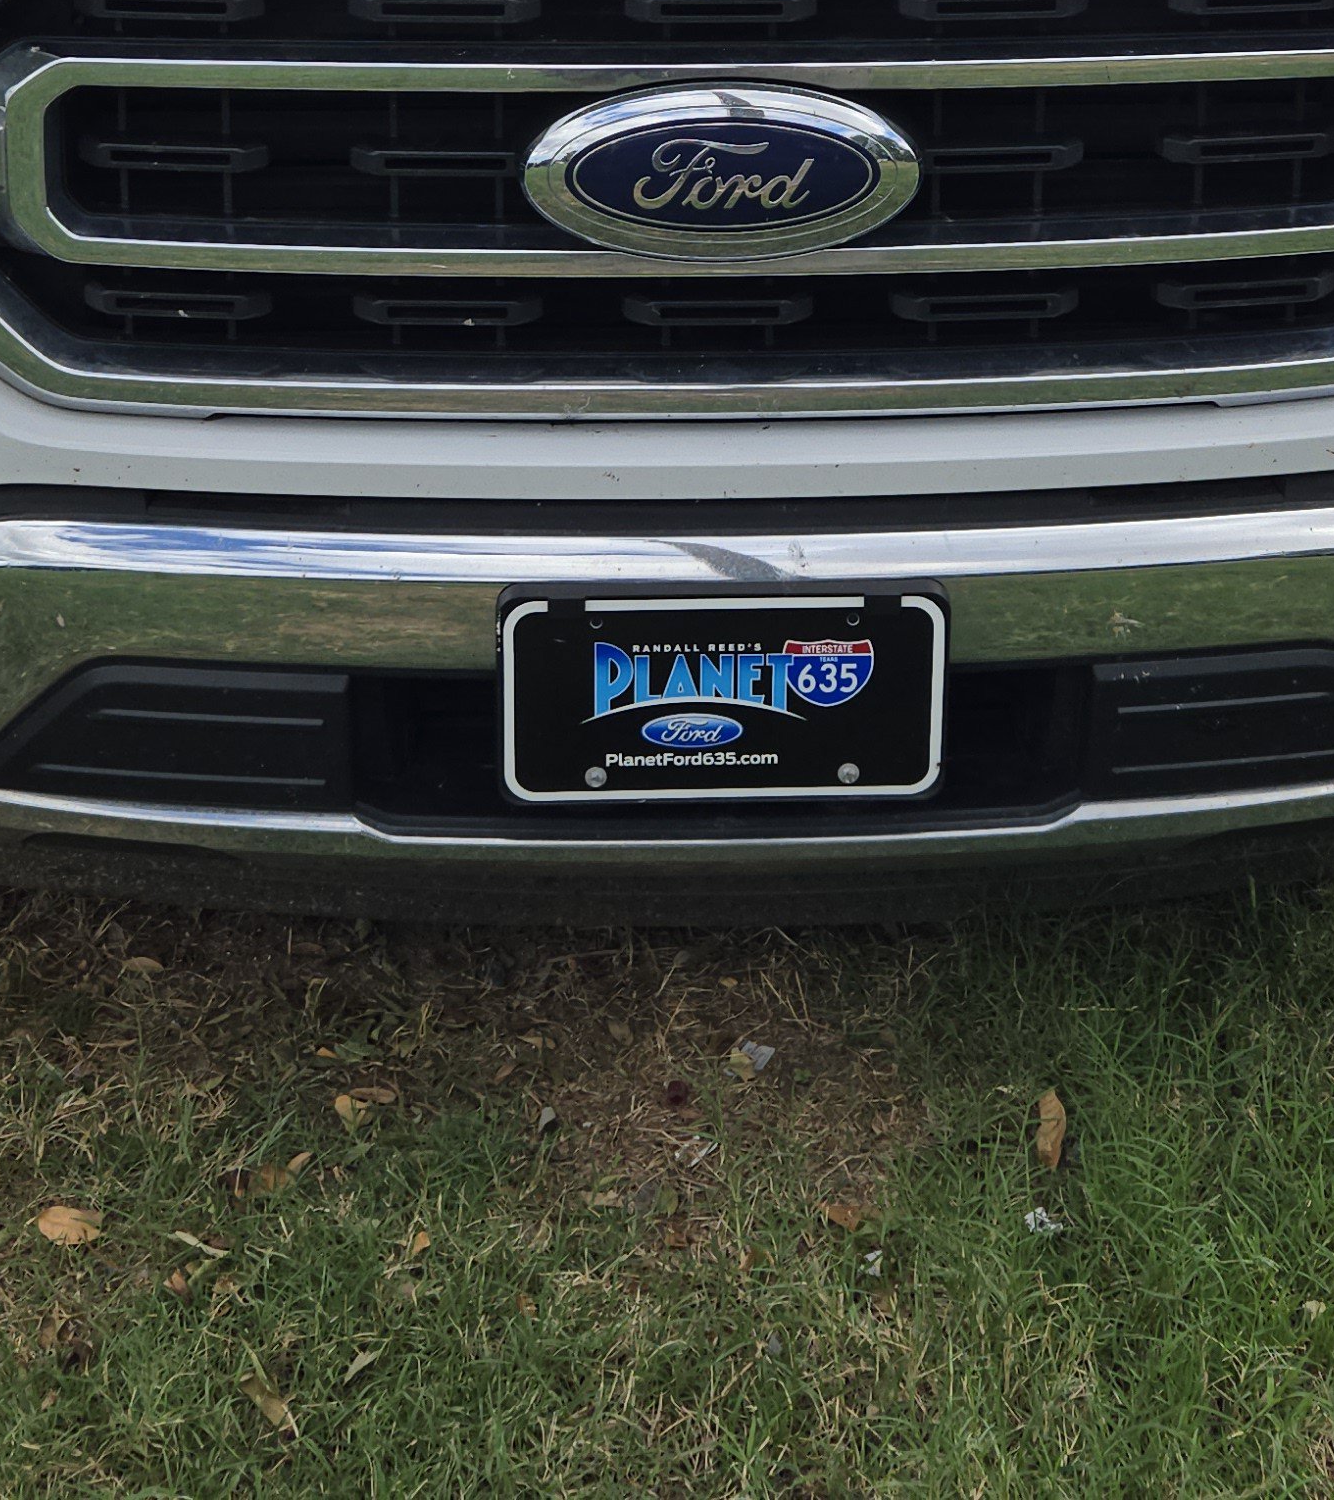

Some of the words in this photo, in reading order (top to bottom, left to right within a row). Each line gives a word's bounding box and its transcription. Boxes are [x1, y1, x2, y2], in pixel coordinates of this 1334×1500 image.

[633, 137, 815, 210] Ford
[632, 643, 700, 653] RANDALL
[708, 642, 762, 652] REED'S
[802, 644, 853, 654] INTERSTATE
[594, 641, 794, 717] PLANET
[798, 662, 858, 694] 635
[660, 718, 723, 743] Ford
[605, 752, 779, 767] PlanetFord635.com
